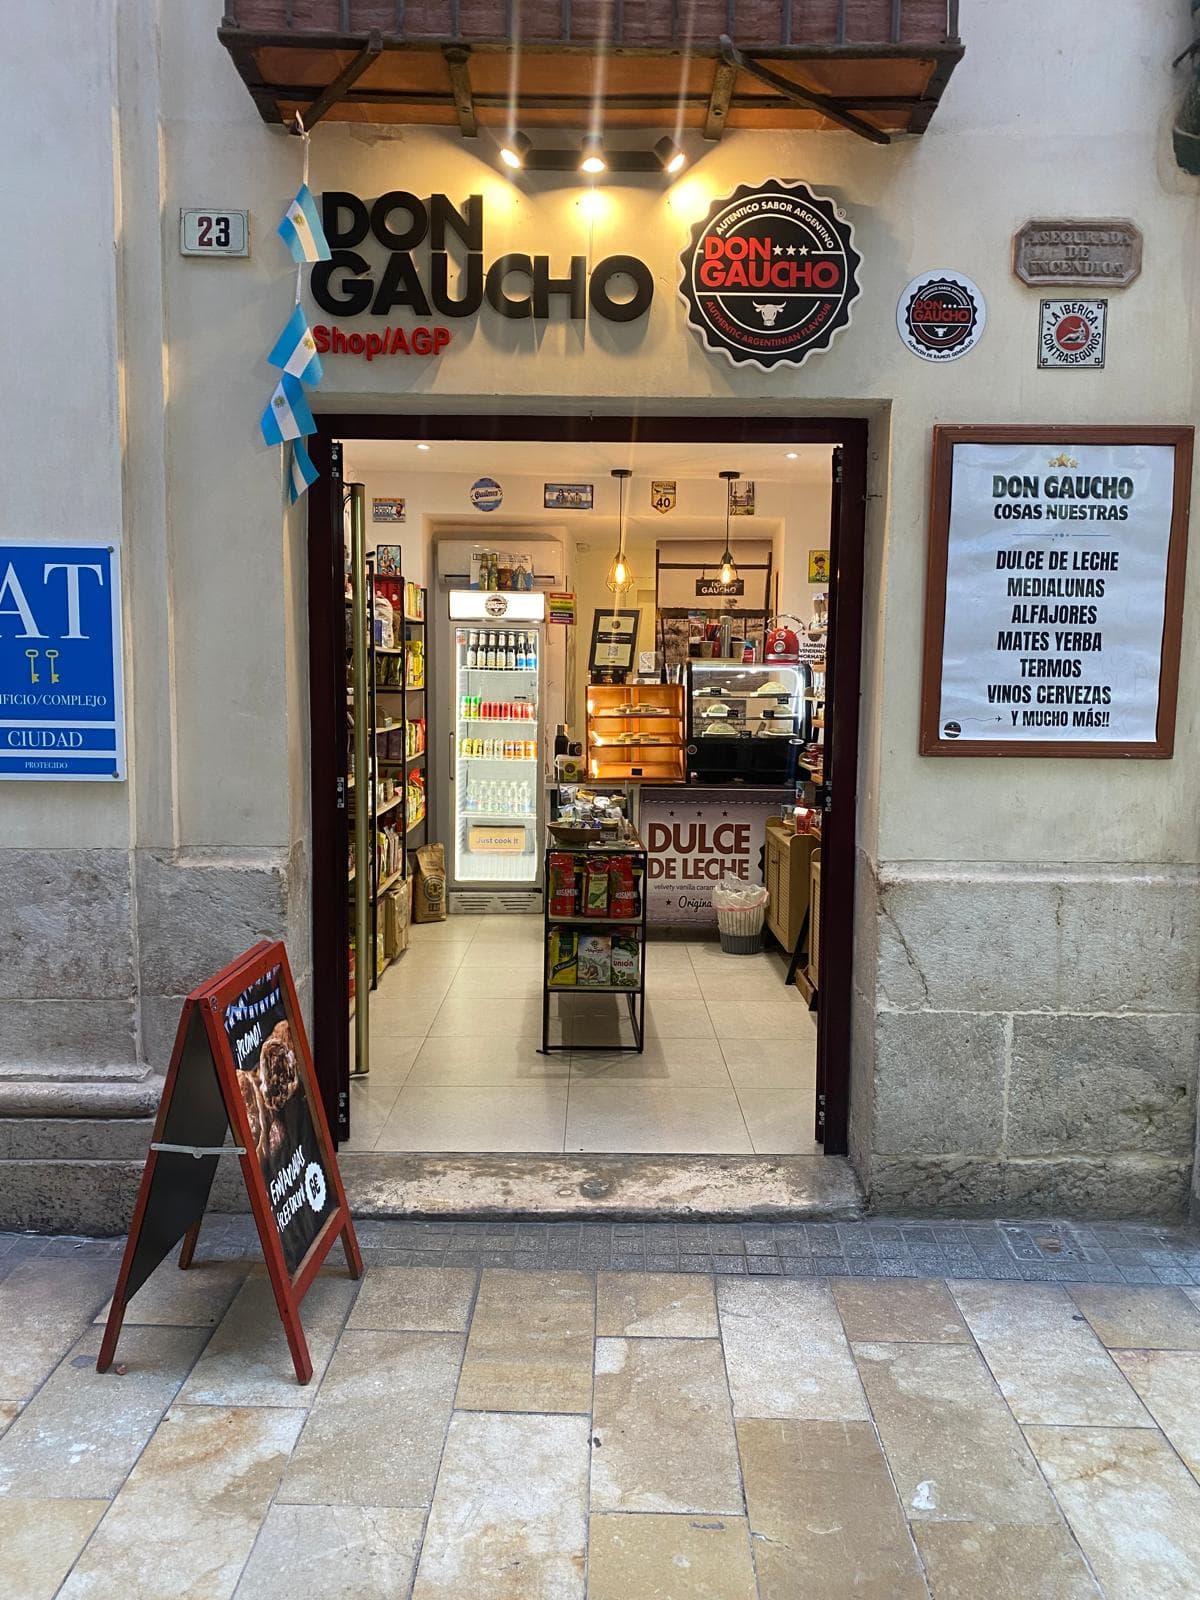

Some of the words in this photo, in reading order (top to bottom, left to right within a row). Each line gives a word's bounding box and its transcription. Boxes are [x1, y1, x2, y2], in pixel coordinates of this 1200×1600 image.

[198, 215, 231, 247] 23
[322, 191, 483, 251] DON
[716, 201, 759, 235] AUTENTICO
[761, 201, 793, 213] SABOR
[794, 207, 834, 249] ARGENTINO
[705, 236, 772, 260] DON
[1064, 247, 1090, 261] DE
[700, 260, 840, 289] GAUCHO
[310, 250, 654, 322] GAUCHO
[914, 309, 969, 322] GAUCHO
[915, 300, 943, 310] DON
[1047, 312, 1061, 327] LA
[1060, 303, 1098, 326] IBERICA
[706, 300, 742, 339] AUTHENTIC
[742, 332, 801, 346] ARGENTINIAN
[801, 303, 832, 337] FLAVOUR
[313, 324, 451, 361] Shop/AGP
[1043, 332, 1101, 364] CONTRASEGUROS
[992, 475, 1039, 498] DON
[1044, 476, 1134, 500] GAUCHO
[656, 497, 671, 508] 40
[994, 503, 1043, 520] COSAS
[1045, 504, 1129, 521] NUESTRAS
[996, 550, 1044, 570] DULCE
[1048, 551, 1068, 571] DE
[1072, 551, 1119, 571] LECHE
[701, 586, 737, 594] GAUCHO
[1007, 577, 1105, 598] MEDIALUNAS
[0, 561, 104, 639] AT
[1011, 604, 1098, 625] ALFAJORES
[997, 631, 1050, 652] MATES
[1055, 631, 1102, 652] YERBA
[1019, 658, 1082, 678] TERMOS
[987, 684, 1032, 704] VINOS
[1036, 685, 1112, 705] CERVEZAS
[1011, 710, 1019, 726] Y
[1022, 710, 1069, 727] MUCHO
[1072, 707, 1110, 728] MÁS!!
[8, 730, 83, 747] CIUDAD
[25, 761, 68, 769] PROTEGIDO
[494, 836, 512, 844] cook
[647, 822, 751, 855] DULCE
[647, 858, 677, 880] DE
[682, 858, 749, 880] LECHE
[678, 895, 713, 912] Origina
